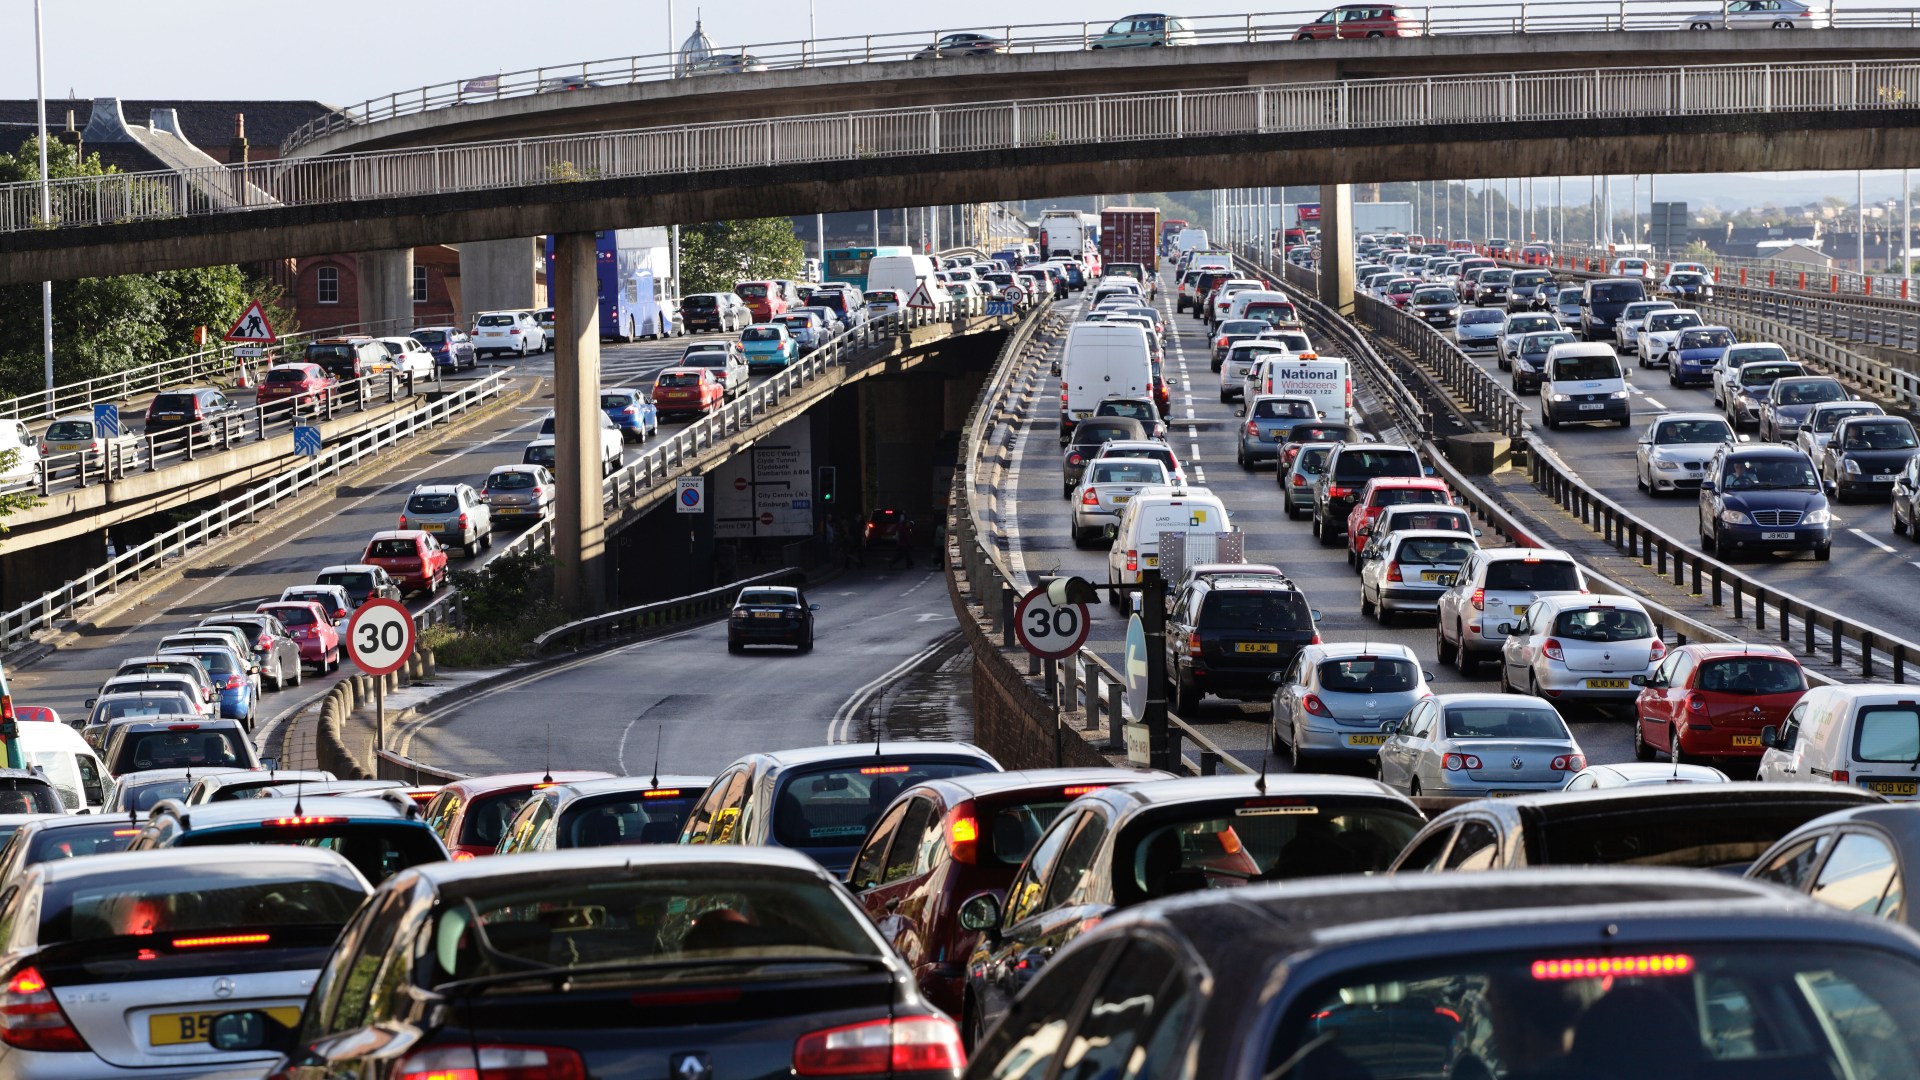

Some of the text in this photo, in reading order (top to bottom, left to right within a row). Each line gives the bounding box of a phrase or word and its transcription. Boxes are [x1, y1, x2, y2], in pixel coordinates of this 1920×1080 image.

[1006, 291, 1020, 300] 50
[1281, 369, 1337, 379] National
[1281, 381, 1337, 389] Windscreens
[795, 490, 808, 498] (N)
[1028, 607, 1078, 638] 30
[358, 620, 404, 654] 30
[1245, 643, 1255, 652] E4
[1590, 680, 1608, 688] NL10
[1352, 735, 1374, 744] SJ07
[1736, 736, 1758, 745] NV57
[1868, 783, 1915, 792] NC08 VCF
